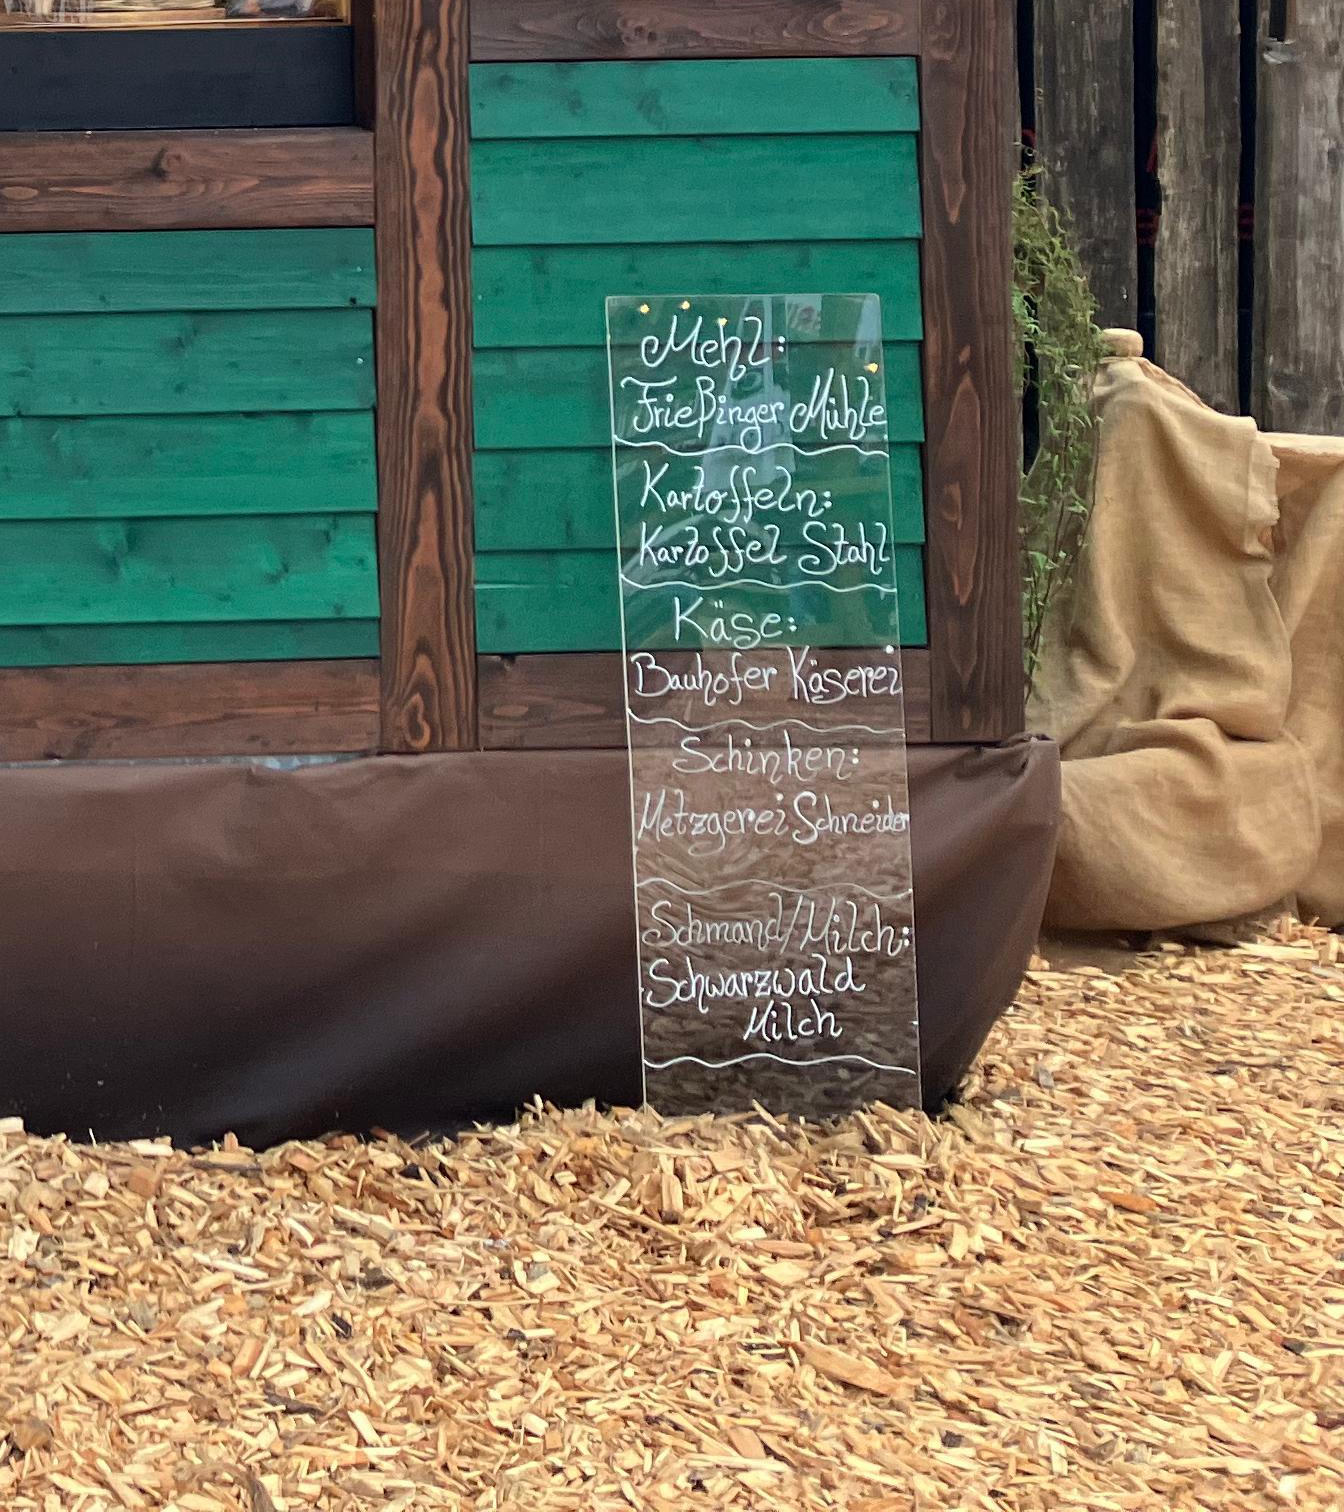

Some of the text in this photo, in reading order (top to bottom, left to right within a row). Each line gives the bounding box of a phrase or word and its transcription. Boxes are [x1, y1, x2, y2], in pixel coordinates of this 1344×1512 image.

[641, 315, 786, 381] Mehl:
[790, 368, 888, 440] Mühle
[640, 461, 832, 524] Kartoffeln:
[639, 521, 890, 577] Kartoffel Stahl
[674, 597, 798, 649] Käse:
[631, 645, 903, 706] Bauhofer Käserei
[673, 730, 859, 784] Schinken:
[638, 789, 911, 856] Metzgerei Schneider
[646, 955, 865, 1013] Schwarzwald
[743, 1000, 843, 1041] Milch
